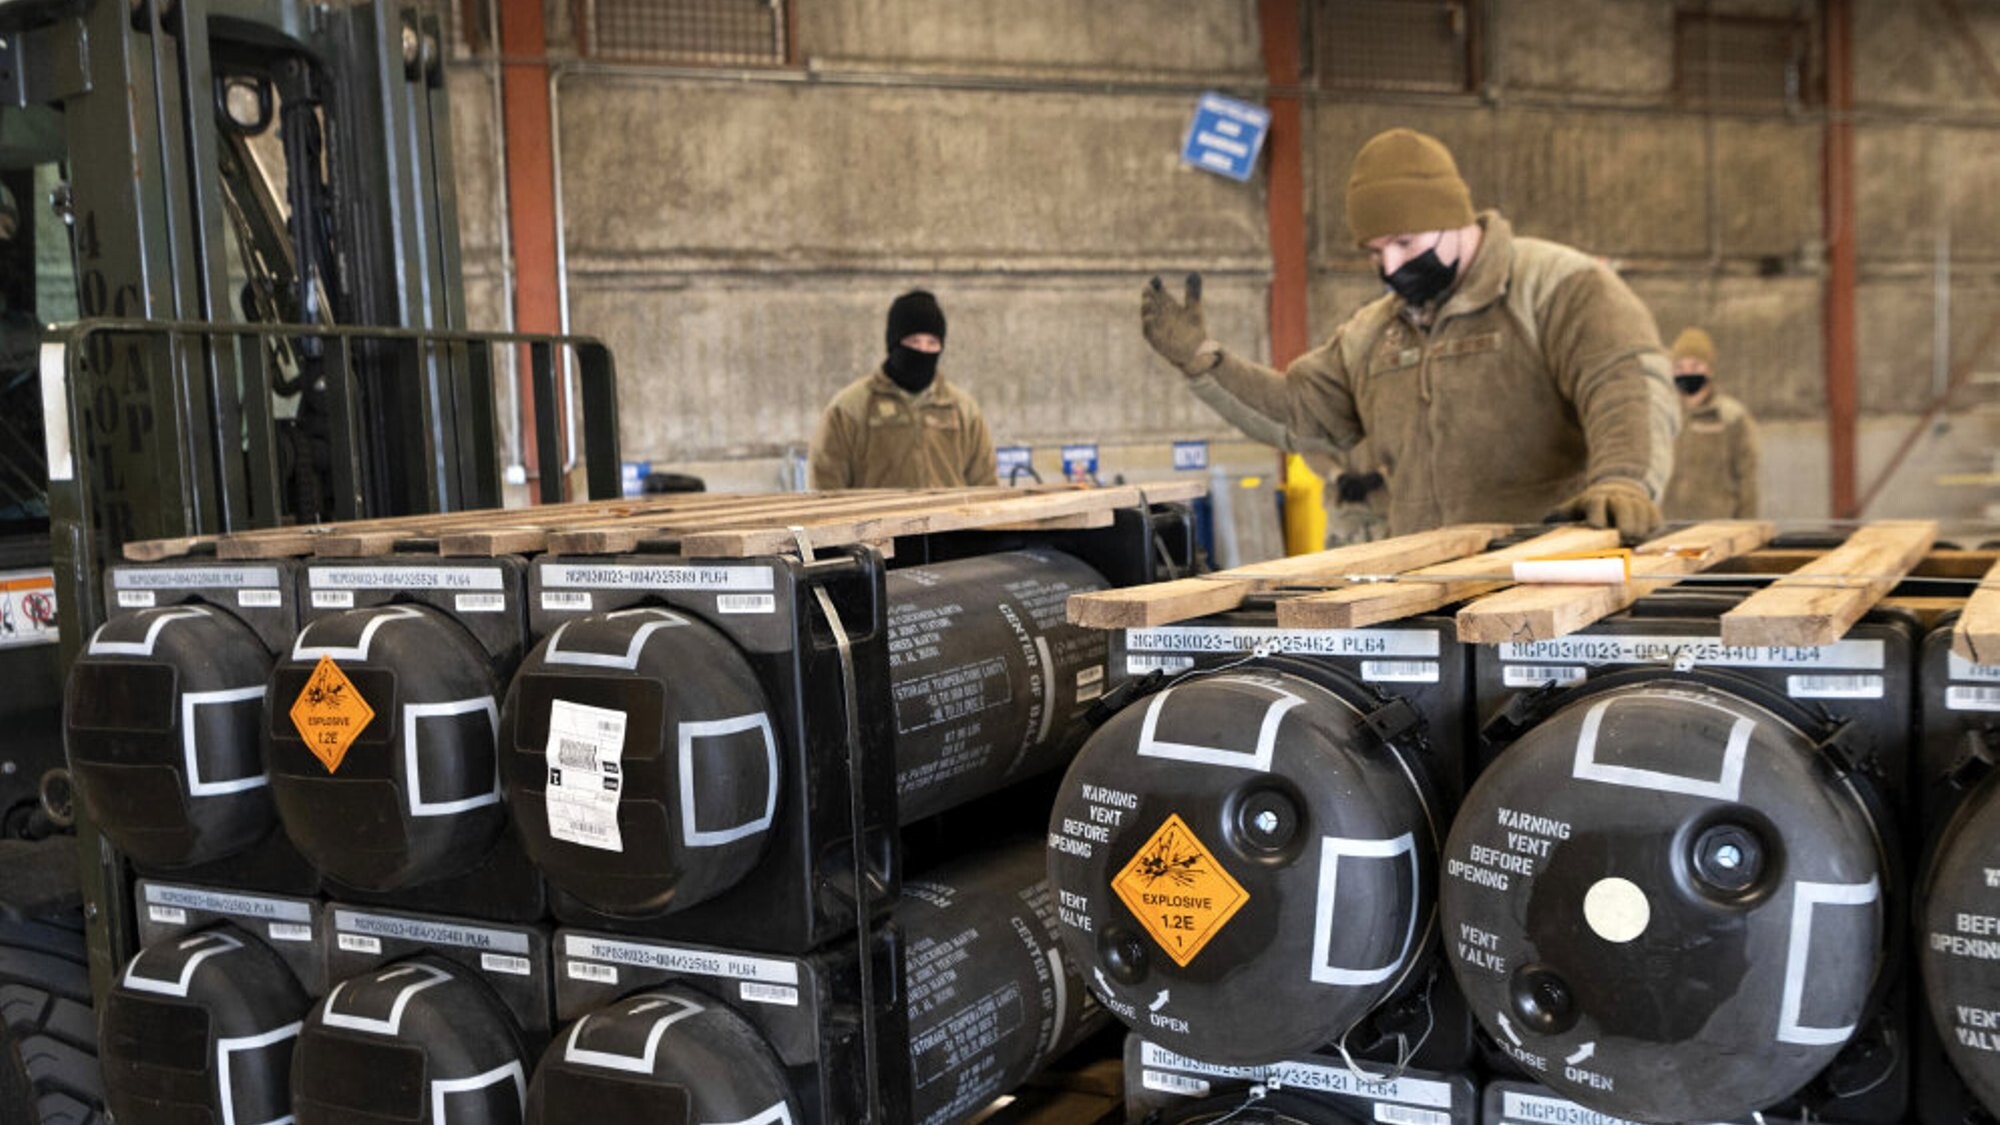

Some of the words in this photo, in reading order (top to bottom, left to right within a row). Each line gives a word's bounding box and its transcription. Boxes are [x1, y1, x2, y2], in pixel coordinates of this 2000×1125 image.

[700, 571, 728, 584] PL64
[999, 604, 1038, 668] CENTER
[1029, 674, 1043, 698] OF
[1344, 637, 1386, 653] PL64
[1768, 645, 1821, 662] PL64
[1082, 784, 1138, 809] WARNING
[1090, 805, 1122, 826] VENT
[1498, 807, 1571, 840] WARNING
[1063, 818, 1109, 844] BEFORE
[1508, 832, 1551, 857] VENT
[1470, 844, 1533, 877] BEFORE
[1448, 859, 1508, 891] OPENING
[1059, 889, 1088, 912] VENT
[1142, 894, 1212, 909] EXPLOSIVE
[1058, 907, 1092, 932] VALVE
[1161, 914, 1195, 930] 1.2E
[1176, 935, 1183, 947] 1
[1460, 923, 1499, 950] VENT
[728, 961, 756, 977] PL64
[1011, 916, 1051, 983] CENTER
[1041, 987, 1054, 1010] OF
[1458, 943, 1506, 973] VALVE
[1150, 1013, 1190, 1034] OPEN
[1496, 1038, 1549, 1072] CLOSE
[1565, 1066, 1614, 1091] OPEN
